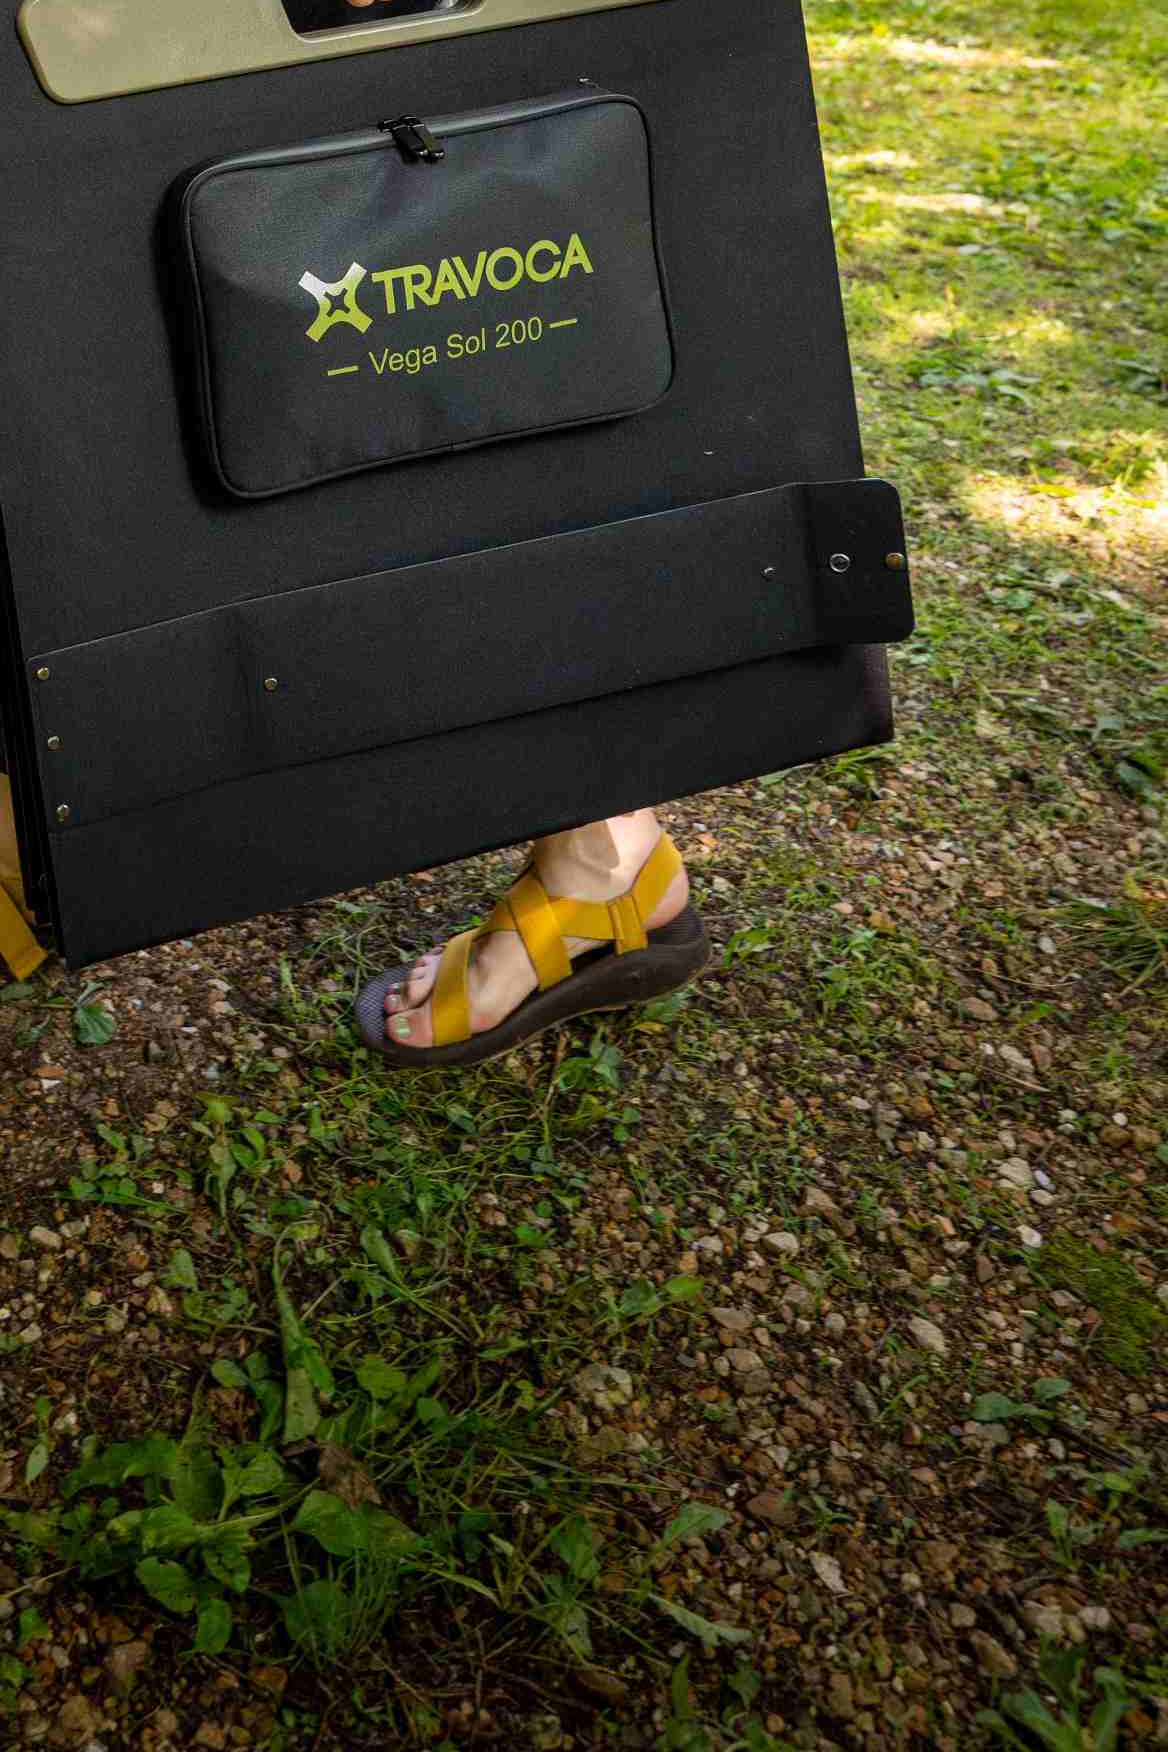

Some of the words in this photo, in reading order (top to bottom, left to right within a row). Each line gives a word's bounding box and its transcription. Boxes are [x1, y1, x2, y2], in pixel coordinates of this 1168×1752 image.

[372, 232, 594, 314] TRAVOCA
[368, 344, 439, 376] Vega
[447, 328, 487, 359] Sol
[496, 318, 545, 349] 200
